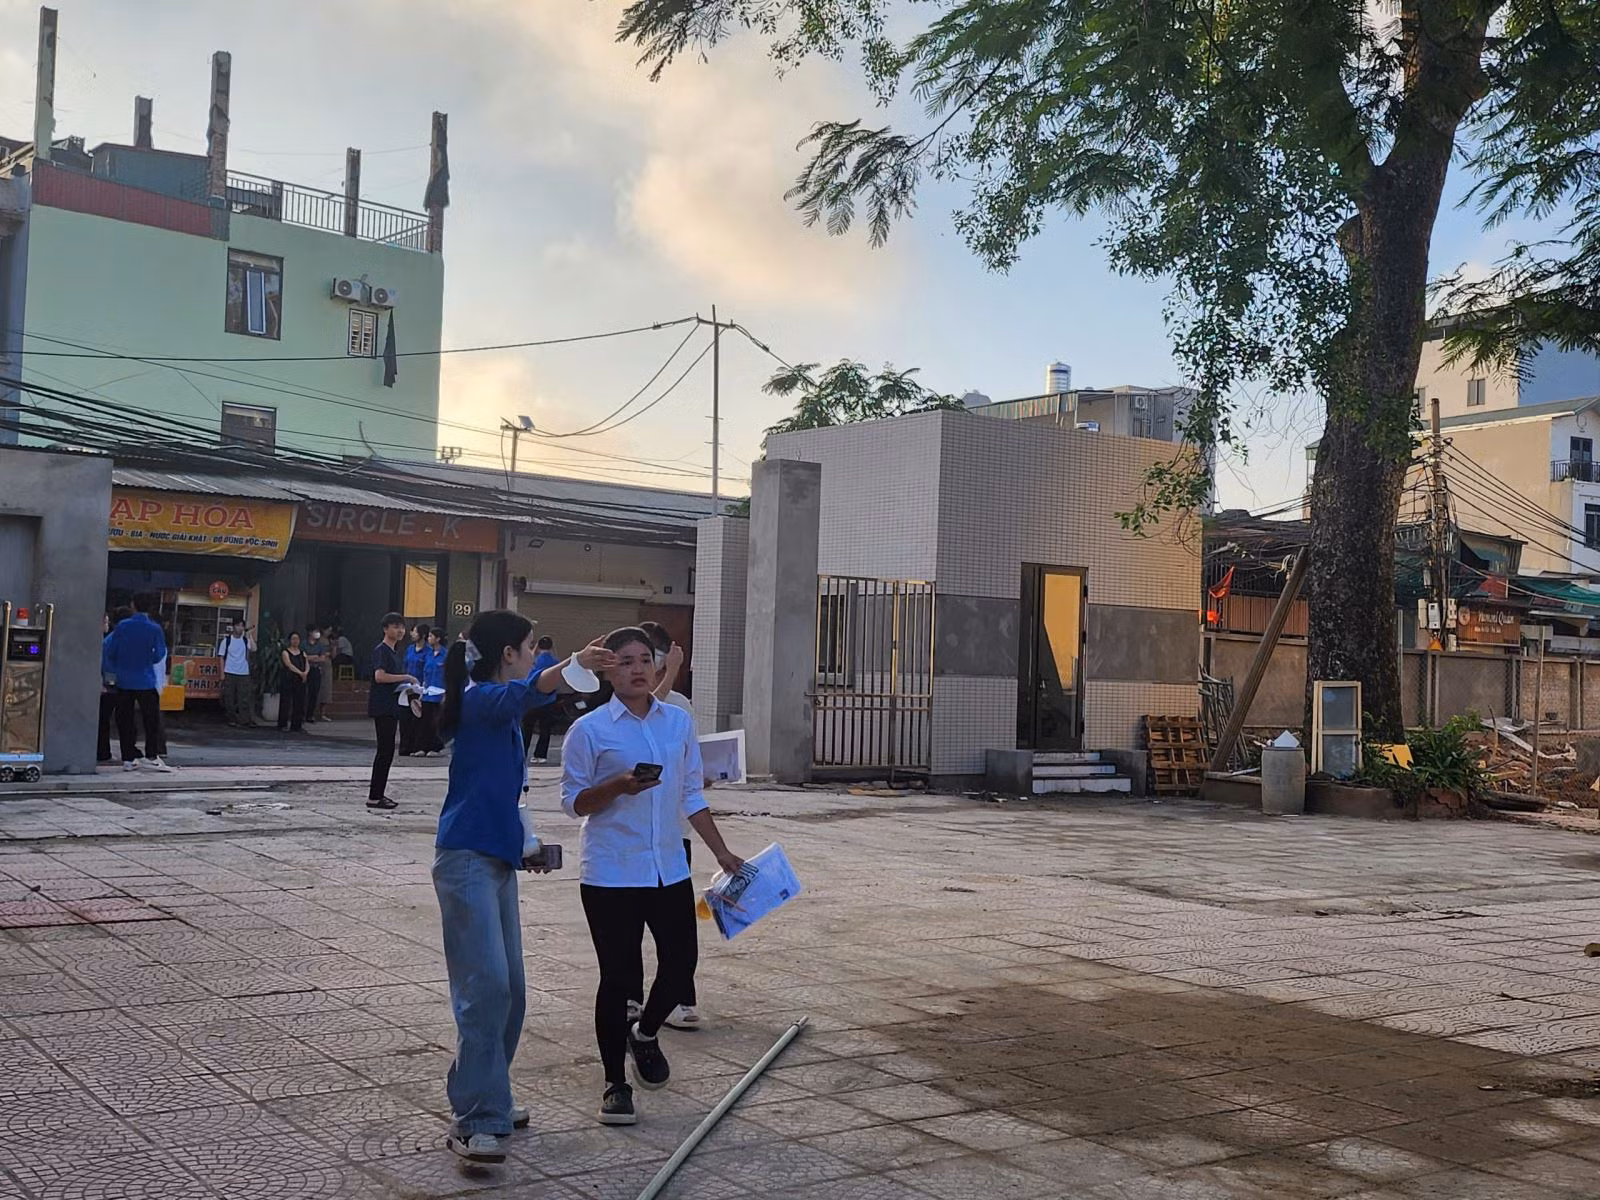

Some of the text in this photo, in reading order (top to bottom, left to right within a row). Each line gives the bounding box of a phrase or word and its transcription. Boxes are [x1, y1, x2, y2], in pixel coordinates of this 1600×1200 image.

[173, 501, 253, 528] HÓA
[307, 504, 414, 534] SIRCLE
[442, 515, 463, 539] K
[455, 604, 471, 616] 29
